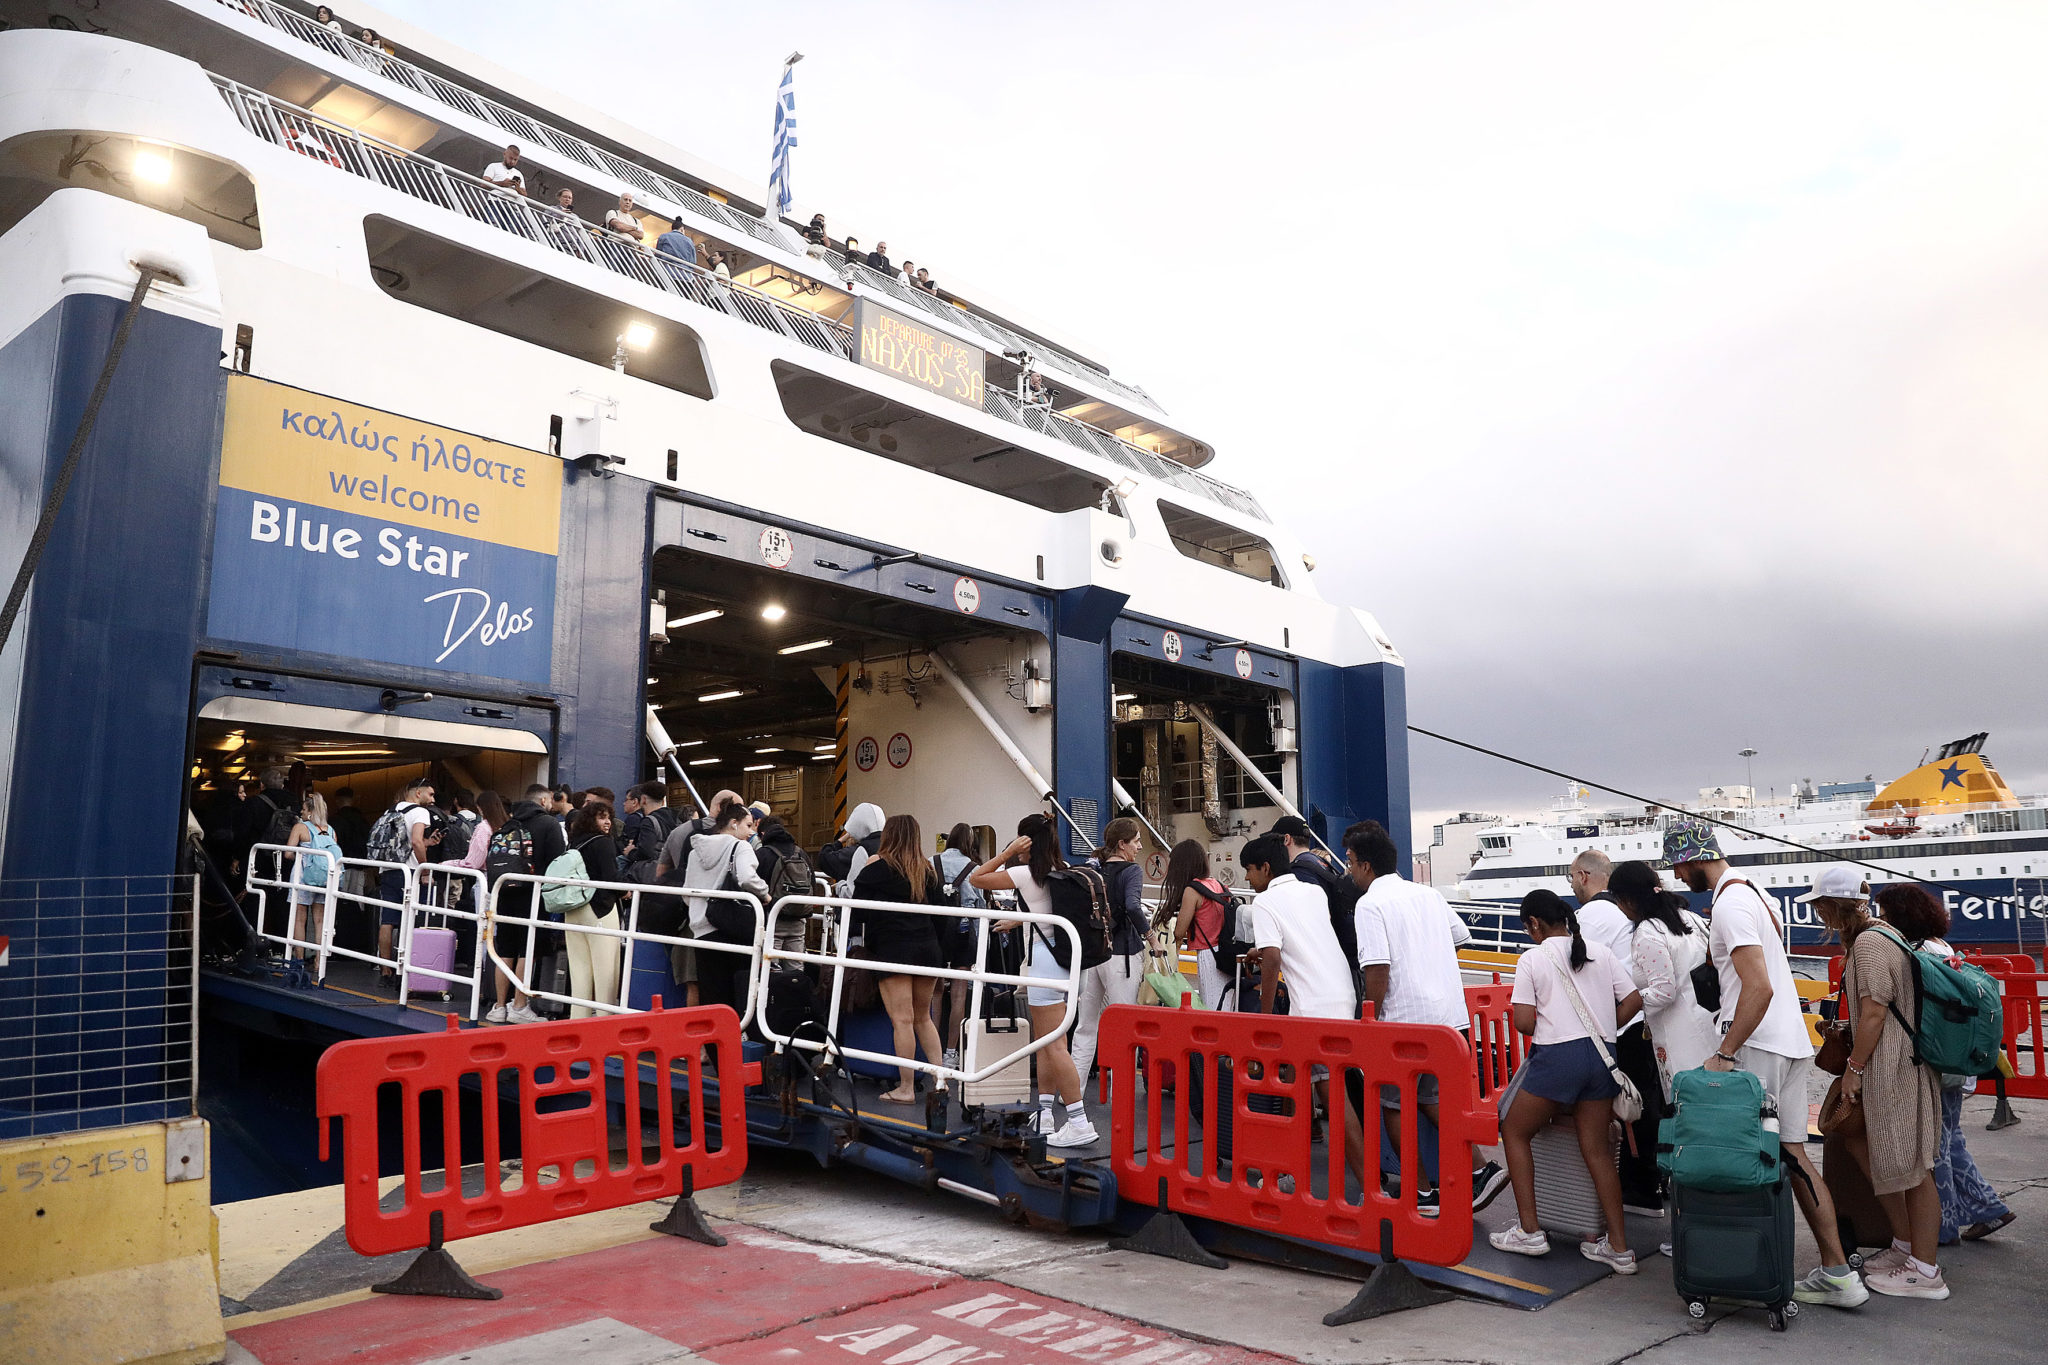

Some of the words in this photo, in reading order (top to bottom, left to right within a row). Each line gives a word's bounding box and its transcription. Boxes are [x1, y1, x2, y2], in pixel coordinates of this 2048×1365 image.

[880, 315, 935, 352] DEPARTURE
[281, 408, 399, 461] καλώς
[411, 434, 527, 488] ήλθατε
[329, 470, 481, 524] welcome
[250, 500, 362, 559] Blue
[376, 527, 470, 579] Star
[424, 588, 534, 663] Delos
[1772, 896, 1826, 924] lu
[1942, 887, 2048, 920] Ferrie
[815, 1323, 1006, 1365] AW
